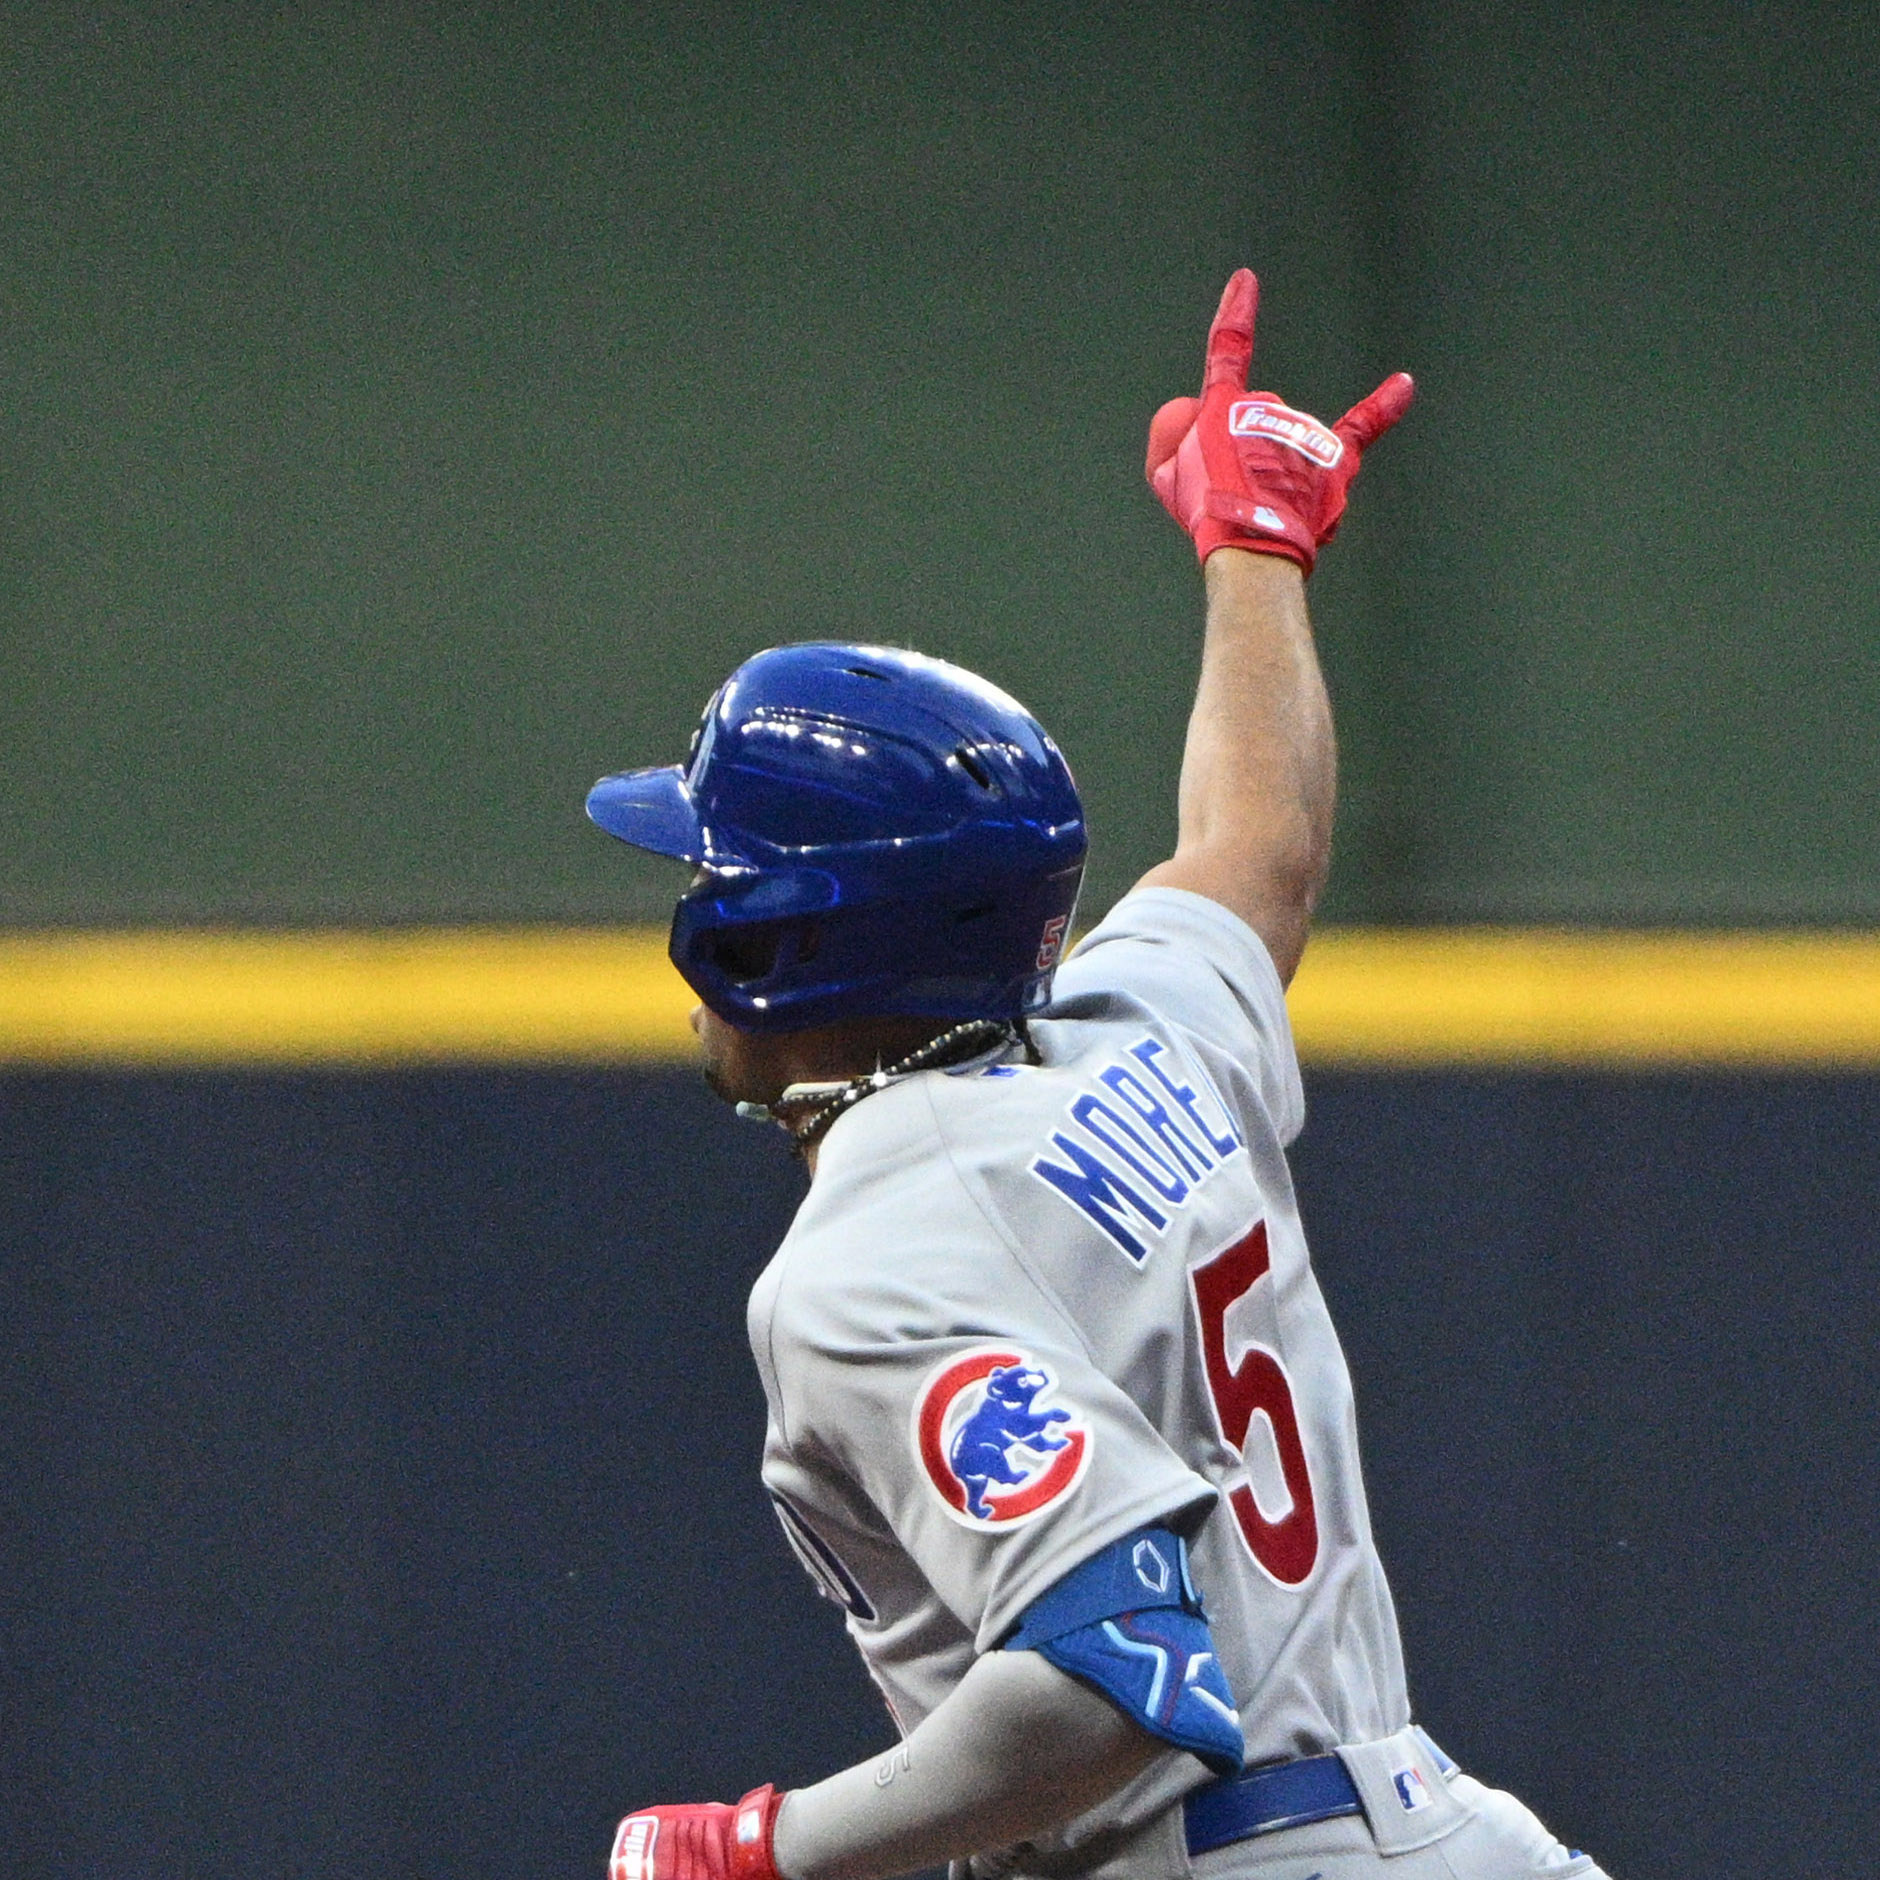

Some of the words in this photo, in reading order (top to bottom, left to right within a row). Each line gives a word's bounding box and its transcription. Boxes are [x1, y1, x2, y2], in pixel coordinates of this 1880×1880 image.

[1036, 914, 1067, 970] 5
[1029, 1035, 1244, 1264] MORE
[1190, 1215, 1320, 1588] 5
